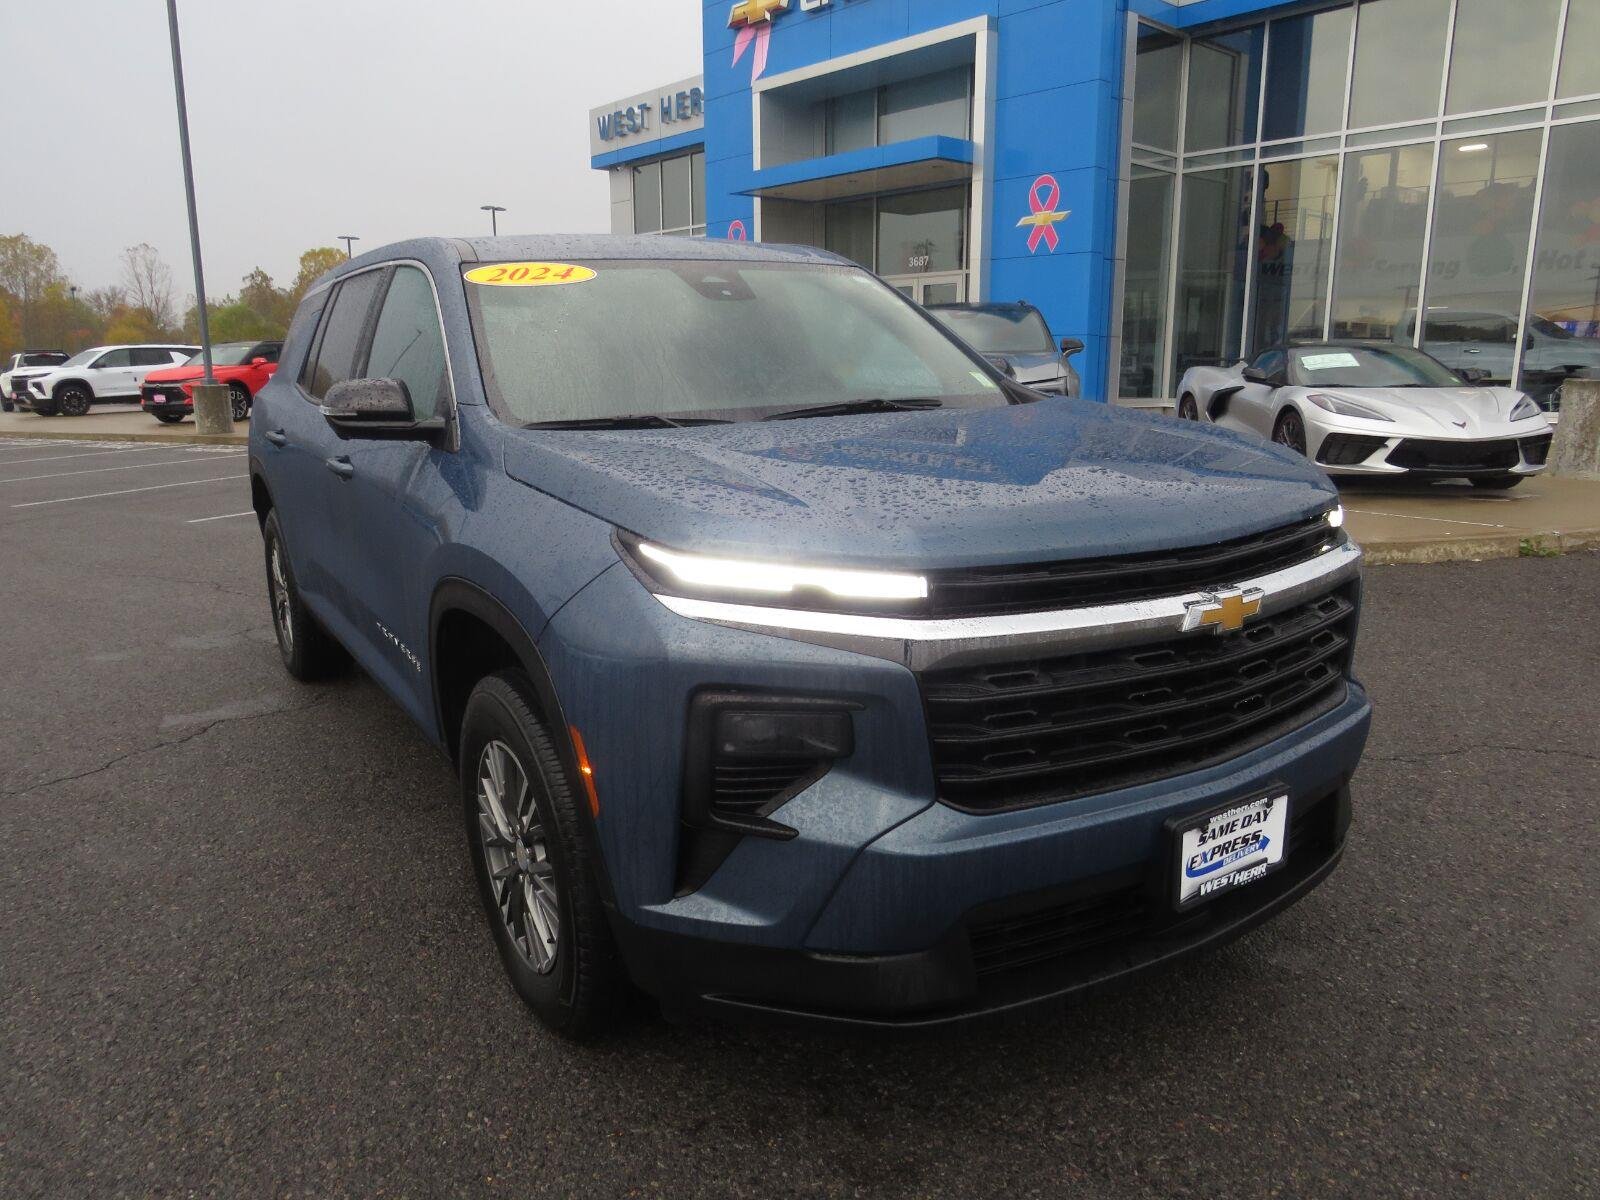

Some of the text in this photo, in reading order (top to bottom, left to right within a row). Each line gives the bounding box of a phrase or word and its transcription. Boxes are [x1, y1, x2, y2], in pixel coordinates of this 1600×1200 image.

[597, 87, 704, 141] WEST HER
[486, 266, 575, 282] 2024
[908, 255, 929, 267] 3687
[1209, 797, 1268, 823] westherr.com
[1197, 807, 1273, 847] SAME DAY
[1190, 829, 1263, 870] EXPRESS
[1222, 841, 1262, 866] DELIVERY
